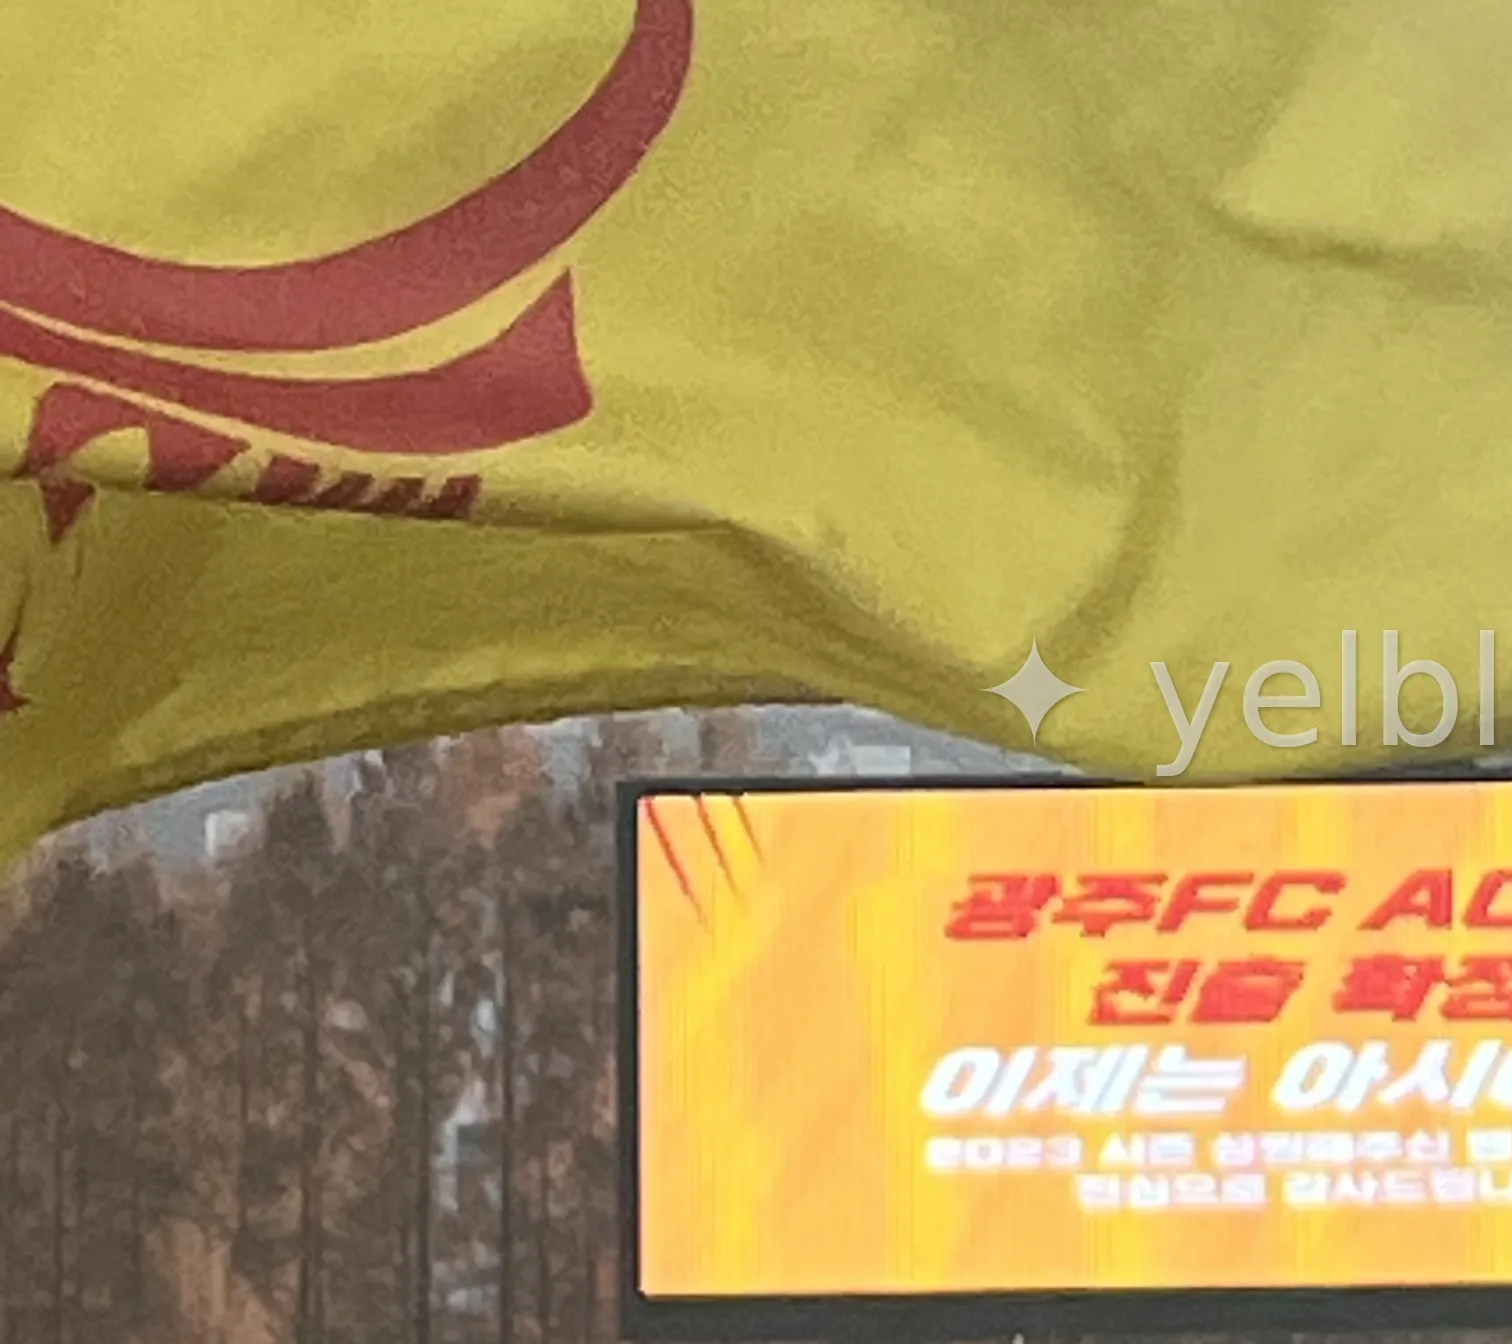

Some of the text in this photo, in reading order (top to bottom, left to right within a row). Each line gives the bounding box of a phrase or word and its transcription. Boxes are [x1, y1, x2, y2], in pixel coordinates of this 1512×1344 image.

[944, 869, 1346, 940] 광주FC
[1087, 955, 1307, 1026] 진출
[919, 1043, 1248, 1115] 이제는
